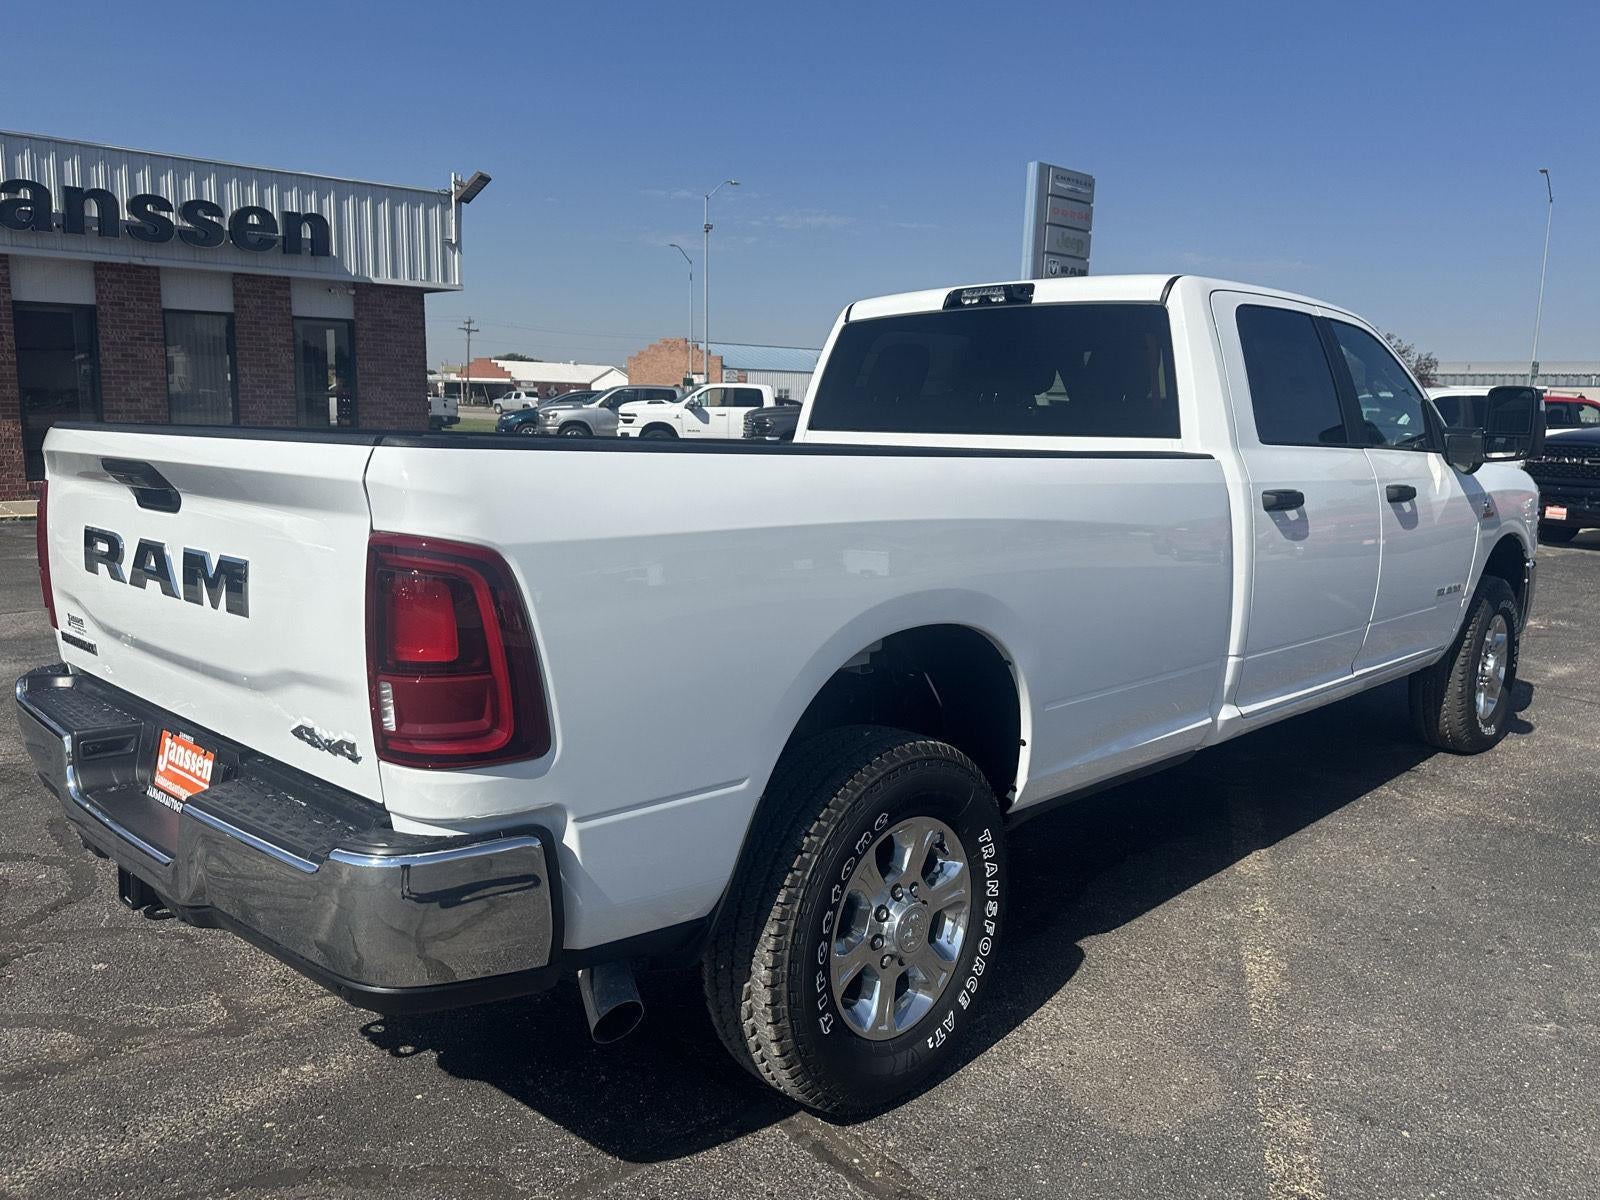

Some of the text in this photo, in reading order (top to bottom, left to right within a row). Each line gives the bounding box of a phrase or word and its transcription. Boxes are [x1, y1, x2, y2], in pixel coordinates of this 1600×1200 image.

[1060, 265, 1088, 276] RAM
[84, 525, 249, 619] RAM
[158, 736, 213, 783] Janssen
[816, 812, 889, 1035] Firestone
[958, 828, 999, 1011] TRANSFORCE
